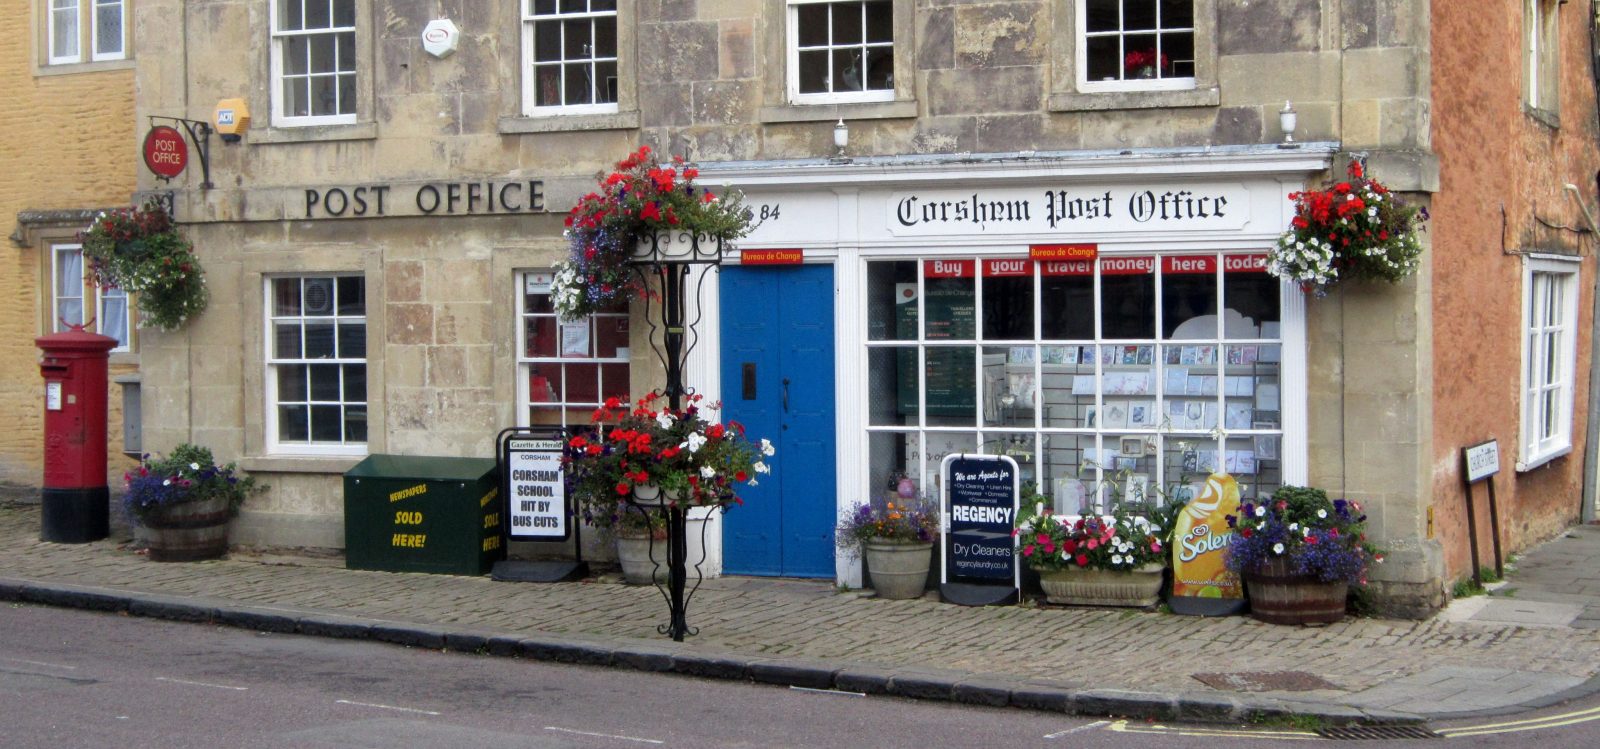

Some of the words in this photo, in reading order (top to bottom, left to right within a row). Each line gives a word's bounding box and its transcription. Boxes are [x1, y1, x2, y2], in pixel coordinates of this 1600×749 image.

[218, 110, 234, 123] ADT
[155, 139, 176, 152] POST
[152, 152, 181, 165] OFFICE
[304, 185, 391, 218] POST
[416, 180, 545, 213] OFFICE
[760, 203, 780, 220] 84
[1045, 189, 1113, 229] Post
[1128, 189, 1228, 222] Office
[742, 251, 765, 260] Bureau
[766, 251, 775, 260] de
[775, 250, 801, 261] Change
[1031, 248, 1056, 257] Bureau
[1057, 247, 1066, 256] de
[1067, 246, 1095, 258] Change
[934, 260, 962, 275] Buy
[991, 260, 1025, 273] your
[1047, 260, 1091, 273] travel
[1101, 258, 1155, 274] money
[1171, 256, 1207, 271] here
[1225, 254, 1268, 270] toda
[511, 441, 534, 449] Gazette
[542, 441, 562, 449] Herald
[513, 469, 559, 482] CORSHAM
[955, 472, 966, 481] We
[978, 470, 998, 482] Agents
[999, 469, 1009, 481] for
[389, 483, 427, 503] NEWSPAPERS
[517, 485, 554, 497] SCHOOL
[520, 500, 536, 512] HIT
[538, 501, 551, 513] BY
[394, 511, 423, 525] SOLD
[953, 505, 1012, 524] REGENCY
[512, 515, 532, 527] BUS
[534, 516, 559, 528] CUTS
[392, 533, 427, 548] HERE!
[1179, 531, 1234, 562] Soler
[953, 543, 970, 557] Dry
[971, 543, 1011, 557] Cleaners
[956, 561, 1009, 570] regencylaundry.co.uk
